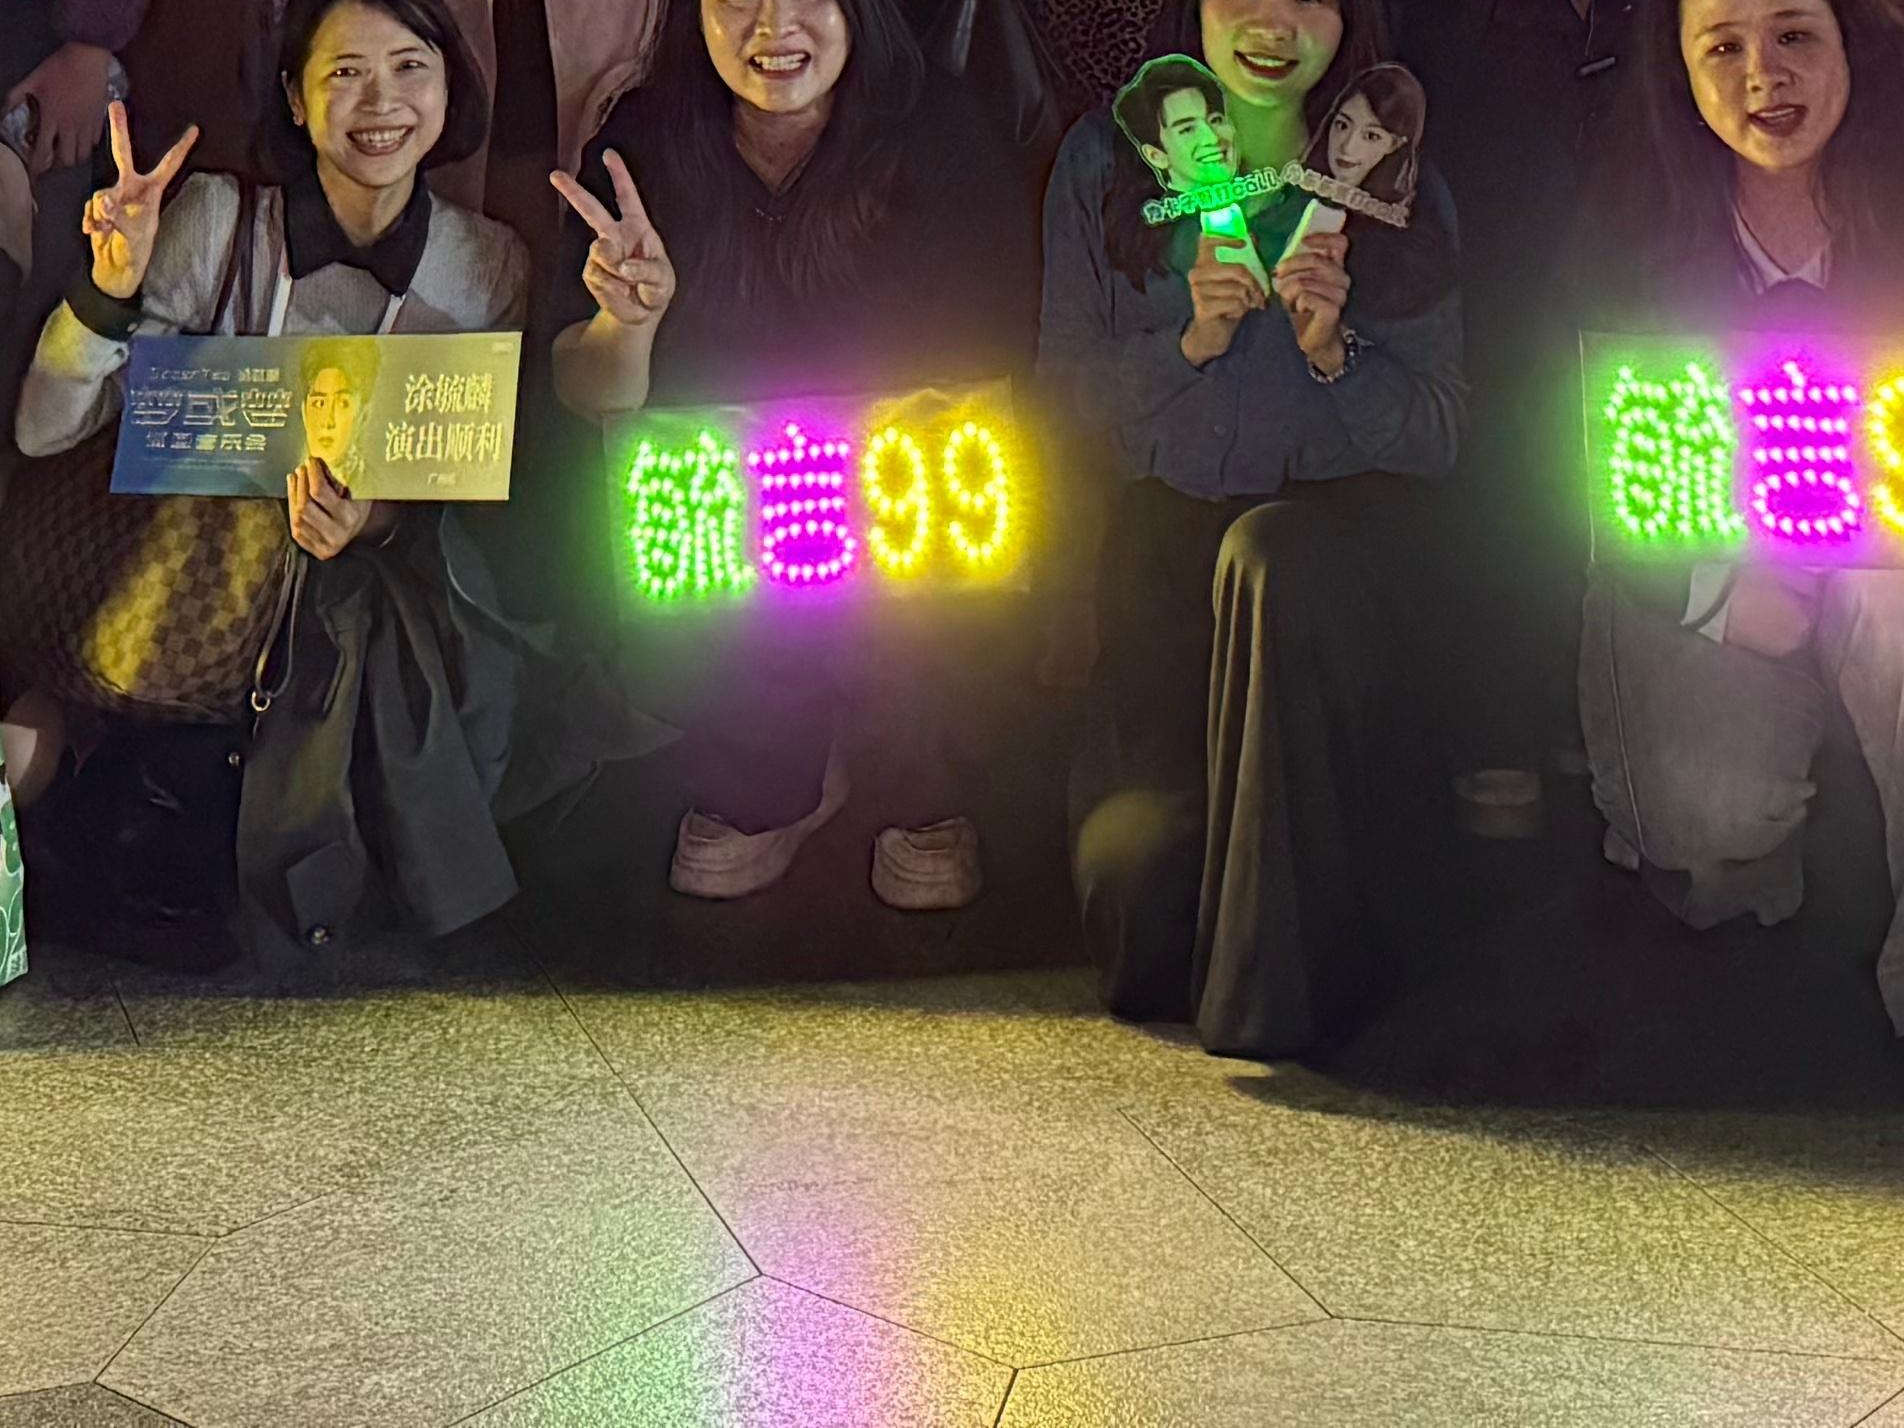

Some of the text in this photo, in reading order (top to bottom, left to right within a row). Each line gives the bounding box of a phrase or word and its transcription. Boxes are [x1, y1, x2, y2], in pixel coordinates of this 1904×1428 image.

[404, 372, 493, 414] 涂毓麟
[385, 420, 503, 463] 演出顺利
